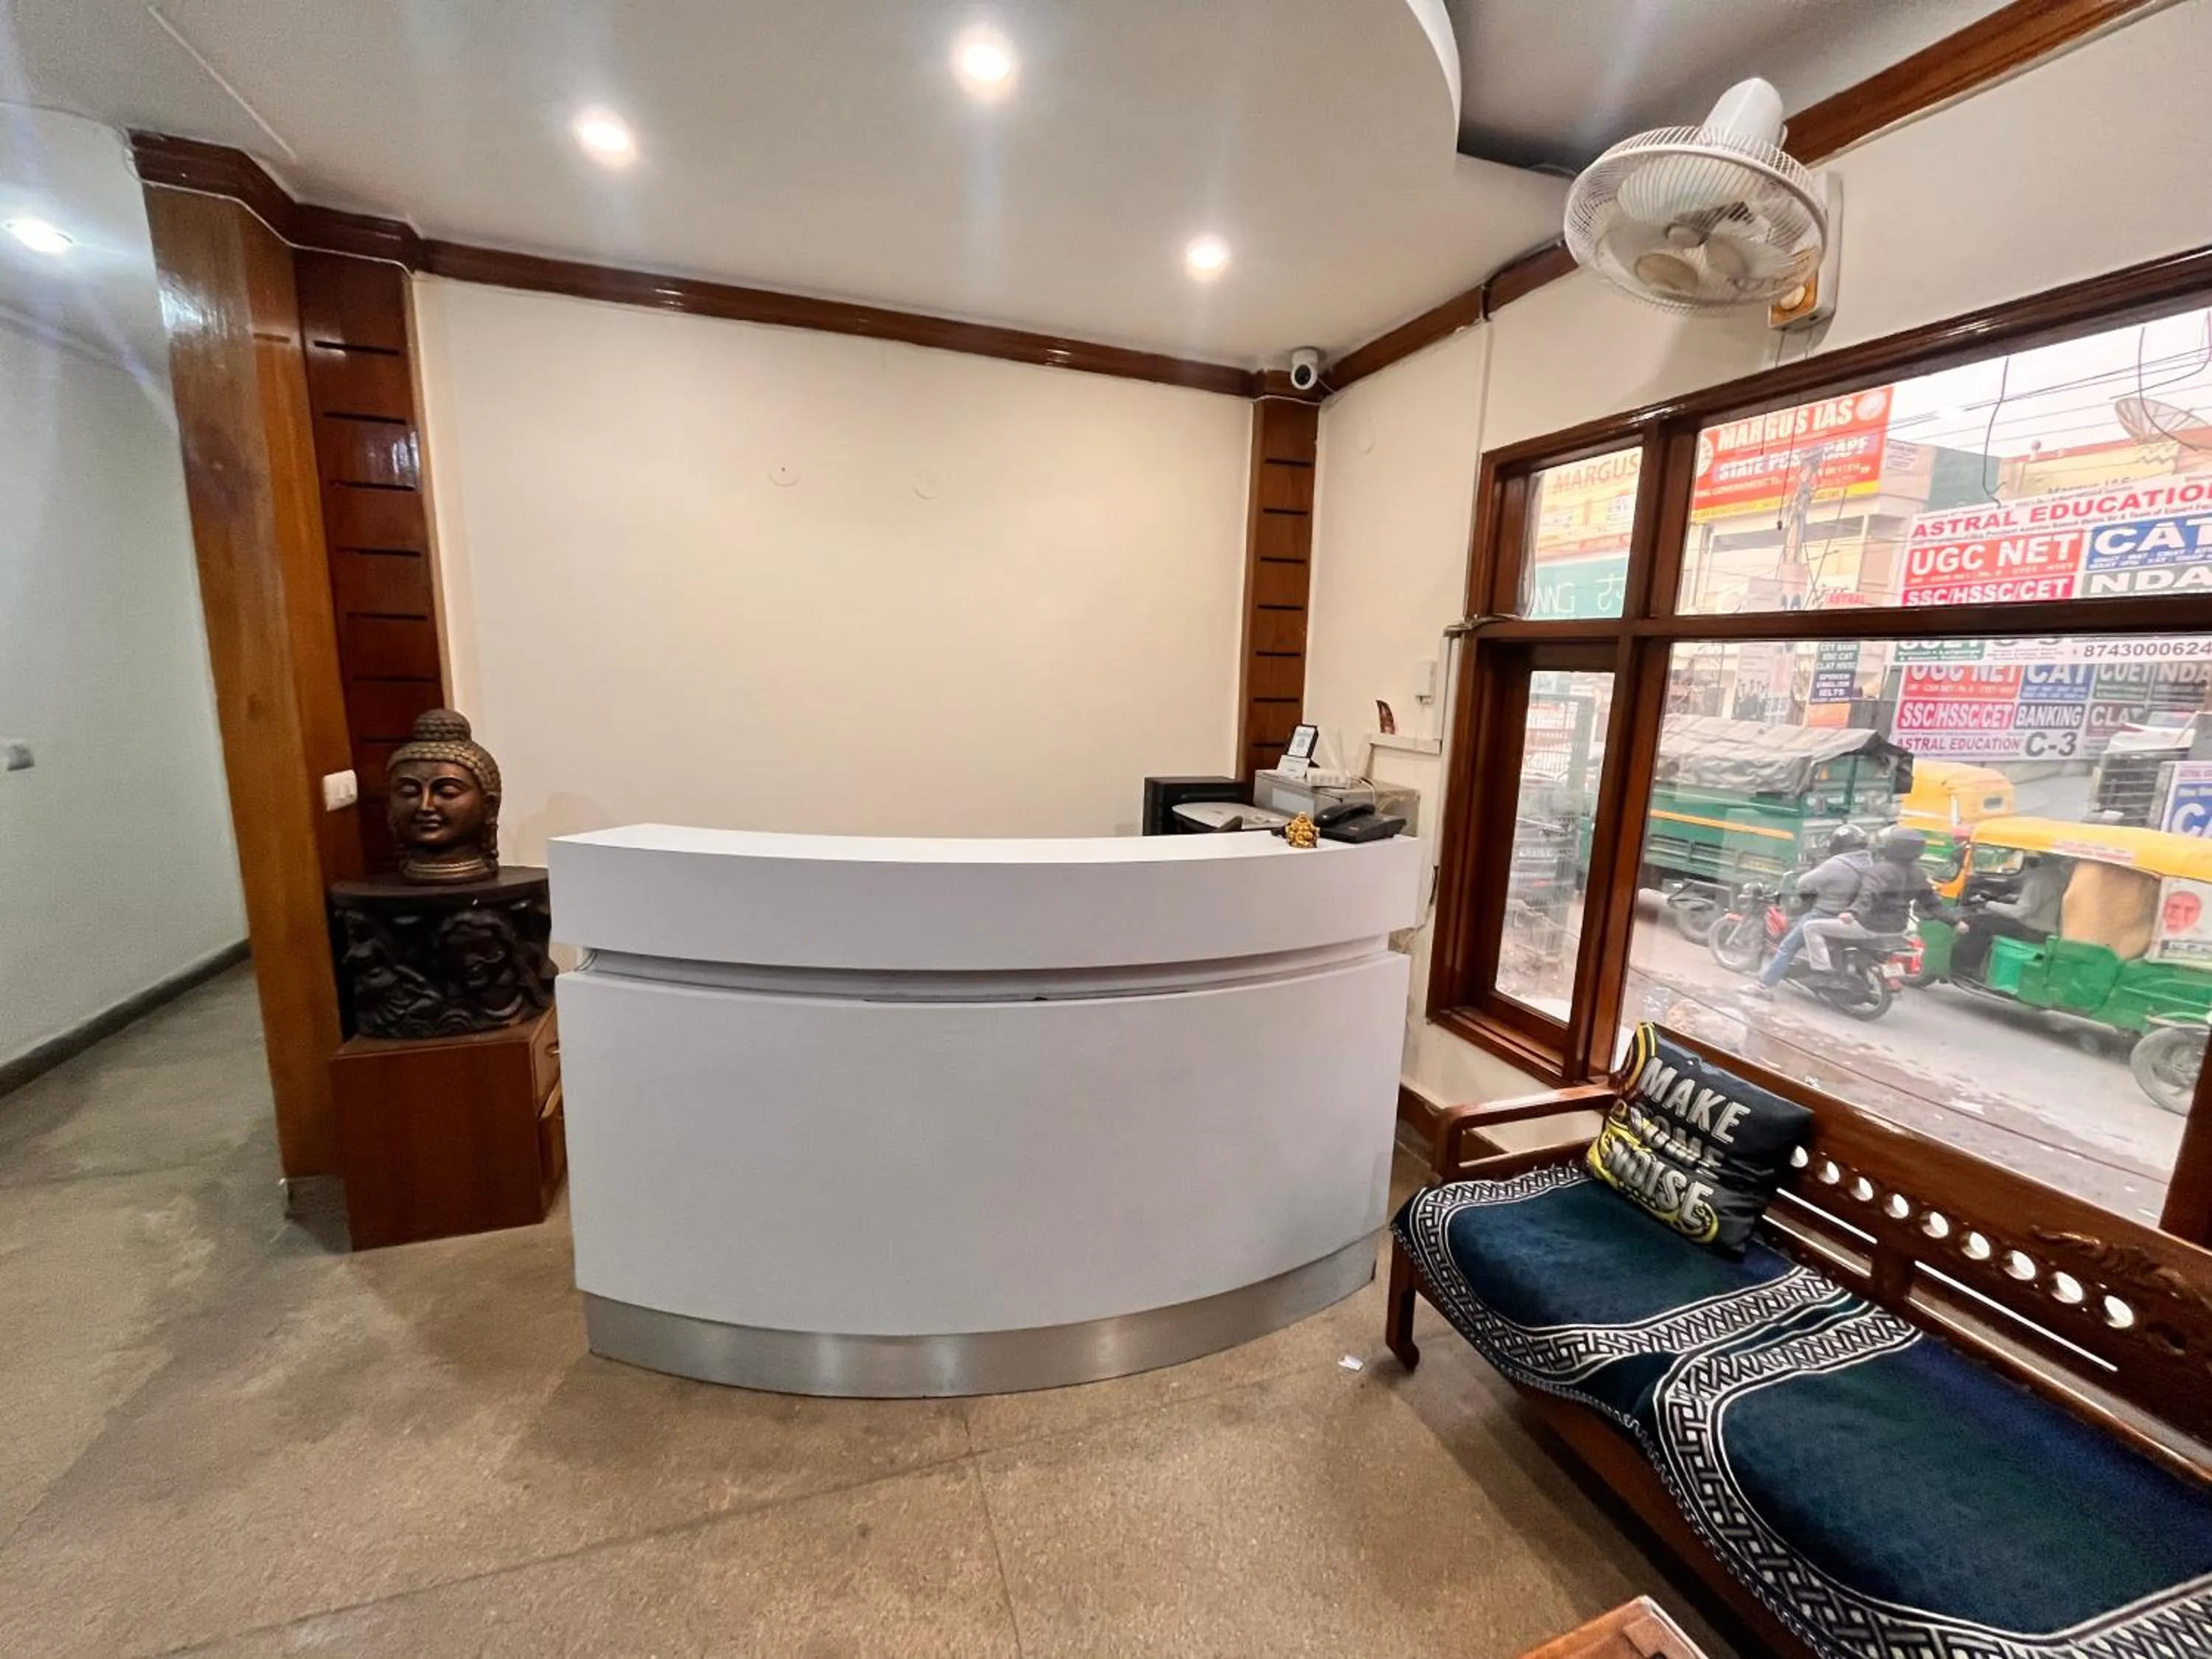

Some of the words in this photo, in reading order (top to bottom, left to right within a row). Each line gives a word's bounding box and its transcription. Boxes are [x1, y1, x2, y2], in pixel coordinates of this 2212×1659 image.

[1717, 407, 1807, 452] MARGUS
[1812, 399, 1854, 431] IAS
[1554, 453, 1639, 493] MARGUS
[1911, 510, 2018, 538] ASTRAL
[2029, 481, 2212, 523] EDUCATIO
[2094, 516, 2212, 556] CAT
[1911, 544, 1986, 576] UGC
[1997, 532, 2080, 568] NET
[1905, 577, 2069, 605] SSC/HSSC/CET
[2090, 566, 2212, 594] NDA
[2083, 641, 2212, 658] 8743000624
[2028, 664, 2087, 684] CAT
[1901, 702, 2013, 728] SSC/HSSC/CET
[2015, 704, 2082, 728] BANKING
[1897, 737, 1947, 751] ASTRAL
[1950, 737, 2021, 751] EDUCATION
[2025, 731, 2077, 757] C-3
[1638, 1057, 1751, 1144] MAKE
